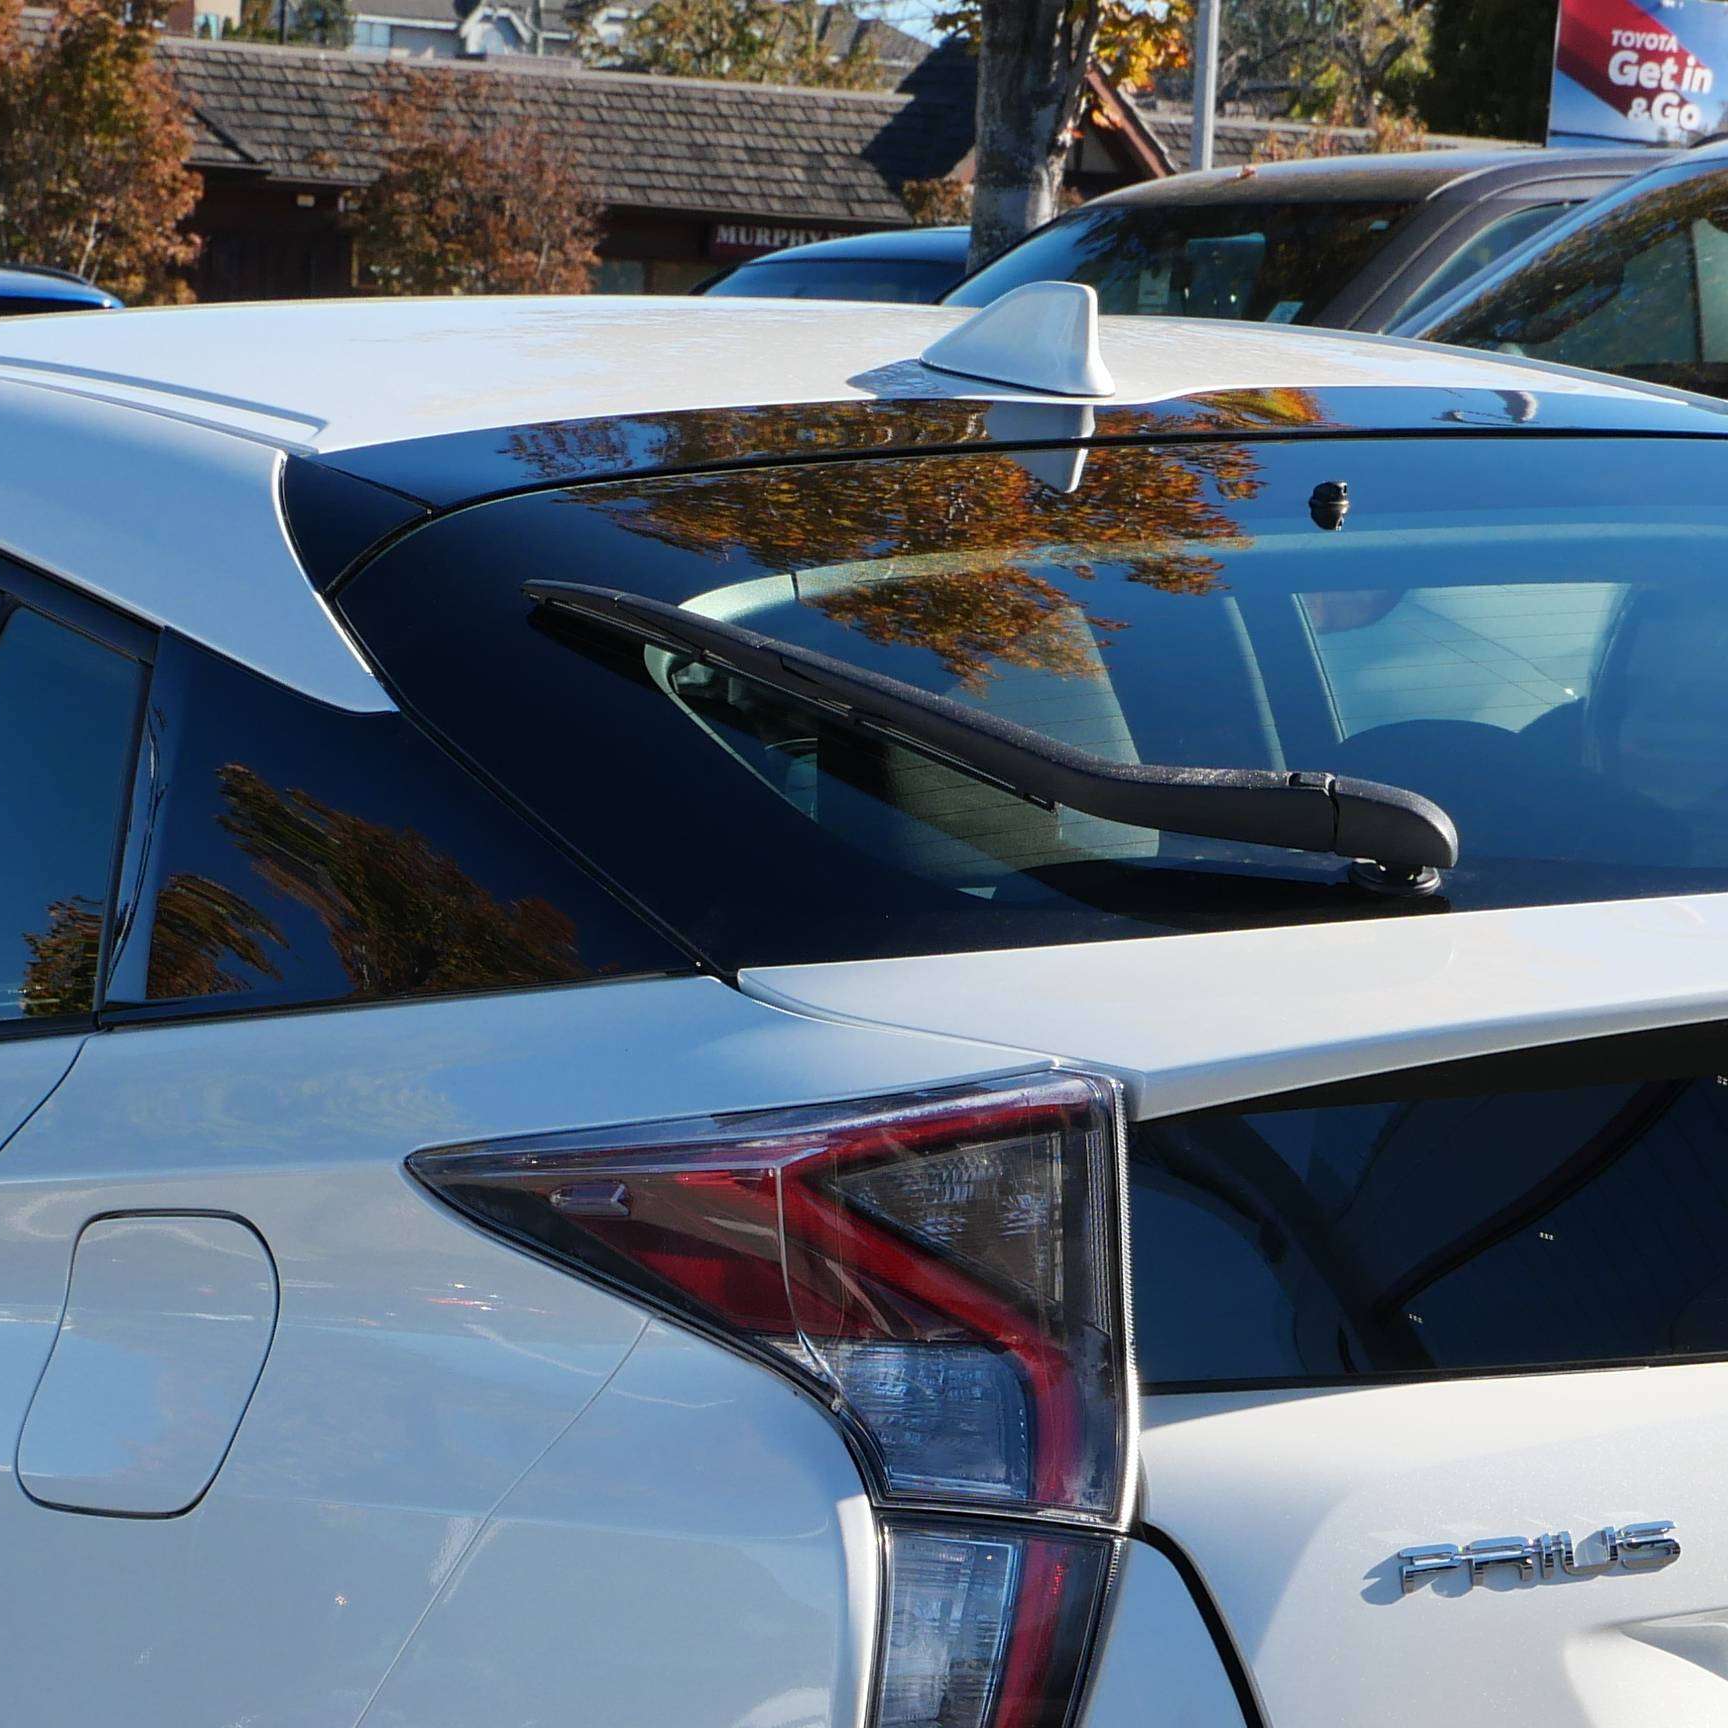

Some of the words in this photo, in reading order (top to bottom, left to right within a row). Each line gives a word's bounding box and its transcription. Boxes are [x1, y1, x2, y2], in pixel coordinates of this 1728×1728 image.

[1611, 29, 1678, 53] TOYOTA
[1608, 50, 1678, 91] Get
[1681, 55, 1714, 95] in
[716, 224, 823, 247] MURPHY
[1397, 1519, 1682, 1595] PRIUS
